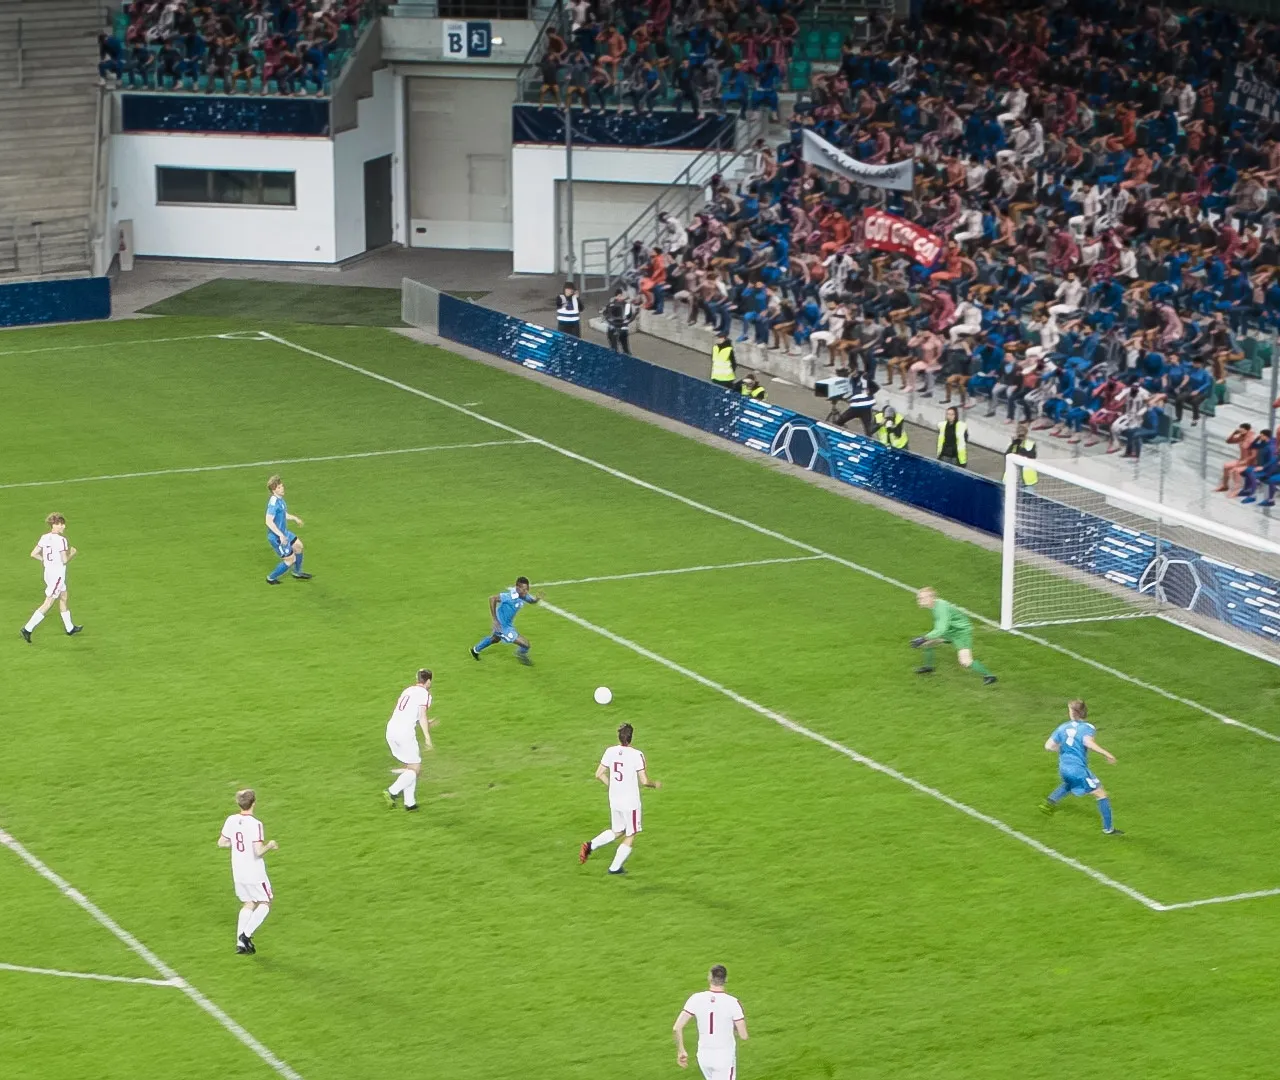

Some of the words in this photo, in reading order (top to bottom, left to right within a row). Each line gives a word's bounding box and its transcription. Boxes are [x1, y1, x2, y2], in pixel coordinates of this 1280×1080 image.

[448, 33, 463, 53] B
[613, 761, 624, 782] 5
[235, 831, 245, 853] 8
